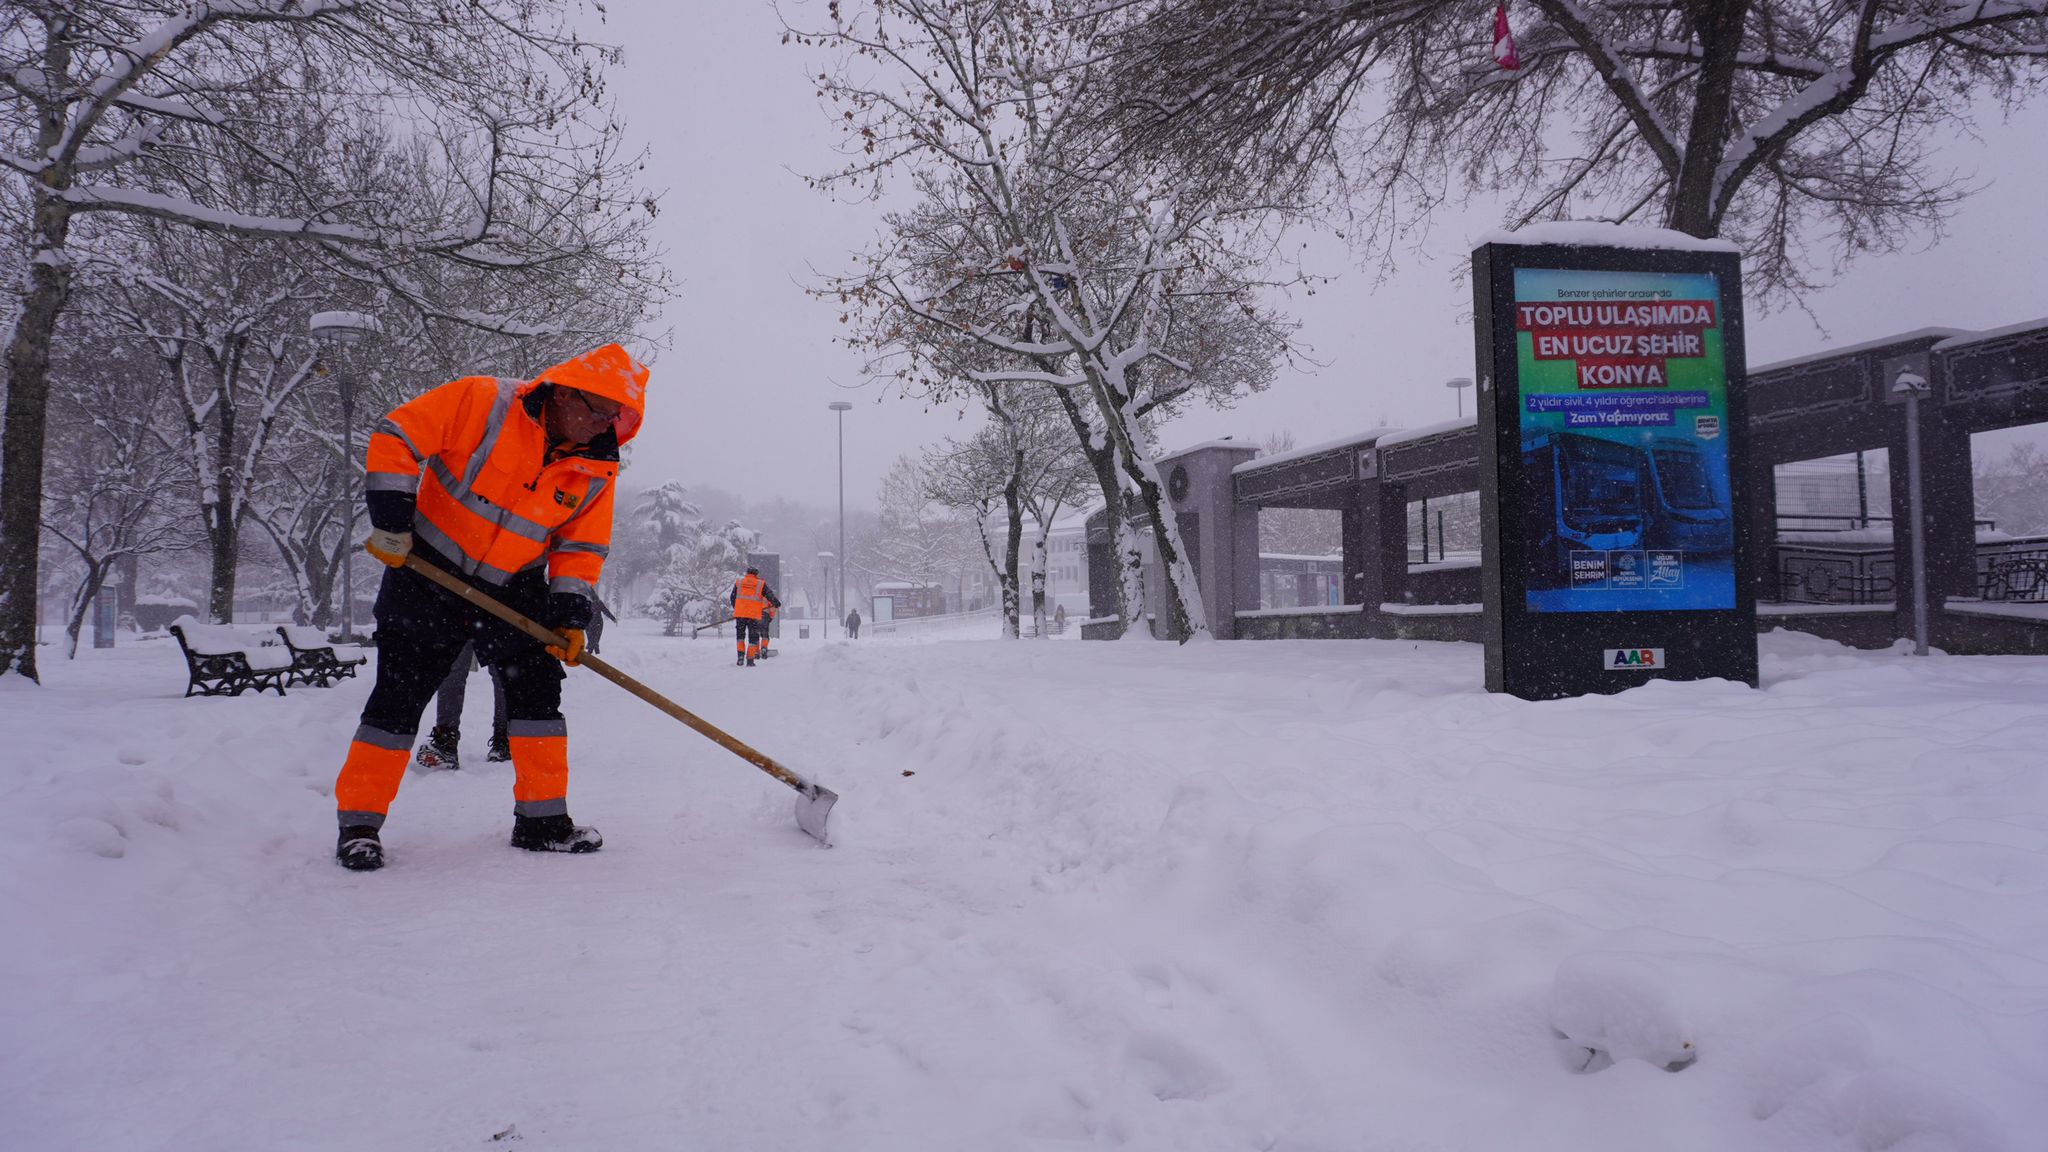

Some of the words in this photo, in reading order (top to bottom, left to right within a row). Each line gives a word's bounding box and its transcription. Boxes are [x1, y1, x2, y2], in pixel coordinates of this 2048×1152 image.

[1557, 289, 1590, 298] Benzer
[1592, 289, 1627, 300] şehirler
[1628, 289, 1672, 298] arasında
[1520, 306, 1592, 325] TOPLU
[1597, 305, 1711, 327] ULAŞIMDA
[1538, 336, 1569, 355] EN
[1573, 336, 1634, 355] UCUZ
[1638, 331, 1699, 356] ŞEHİR
[1581, 365, 1663, 384] KONYA
[1530, 398, 1536, 407] 2
[1538, 397, 1562, 409] yıldır
[1586, 397, 1592, 405] 4
[1594, 396, 1618, 408] yıldır
[1570, 412, 1597, 423] Zam
[1599, 409, 1670, 425] Yapmıyoruz
[1574, 560, 1605, 570] BENİM
[1574, 571, 1605, 580] ŞEHRİM
[1614, 650, 1655, 665] AAR
